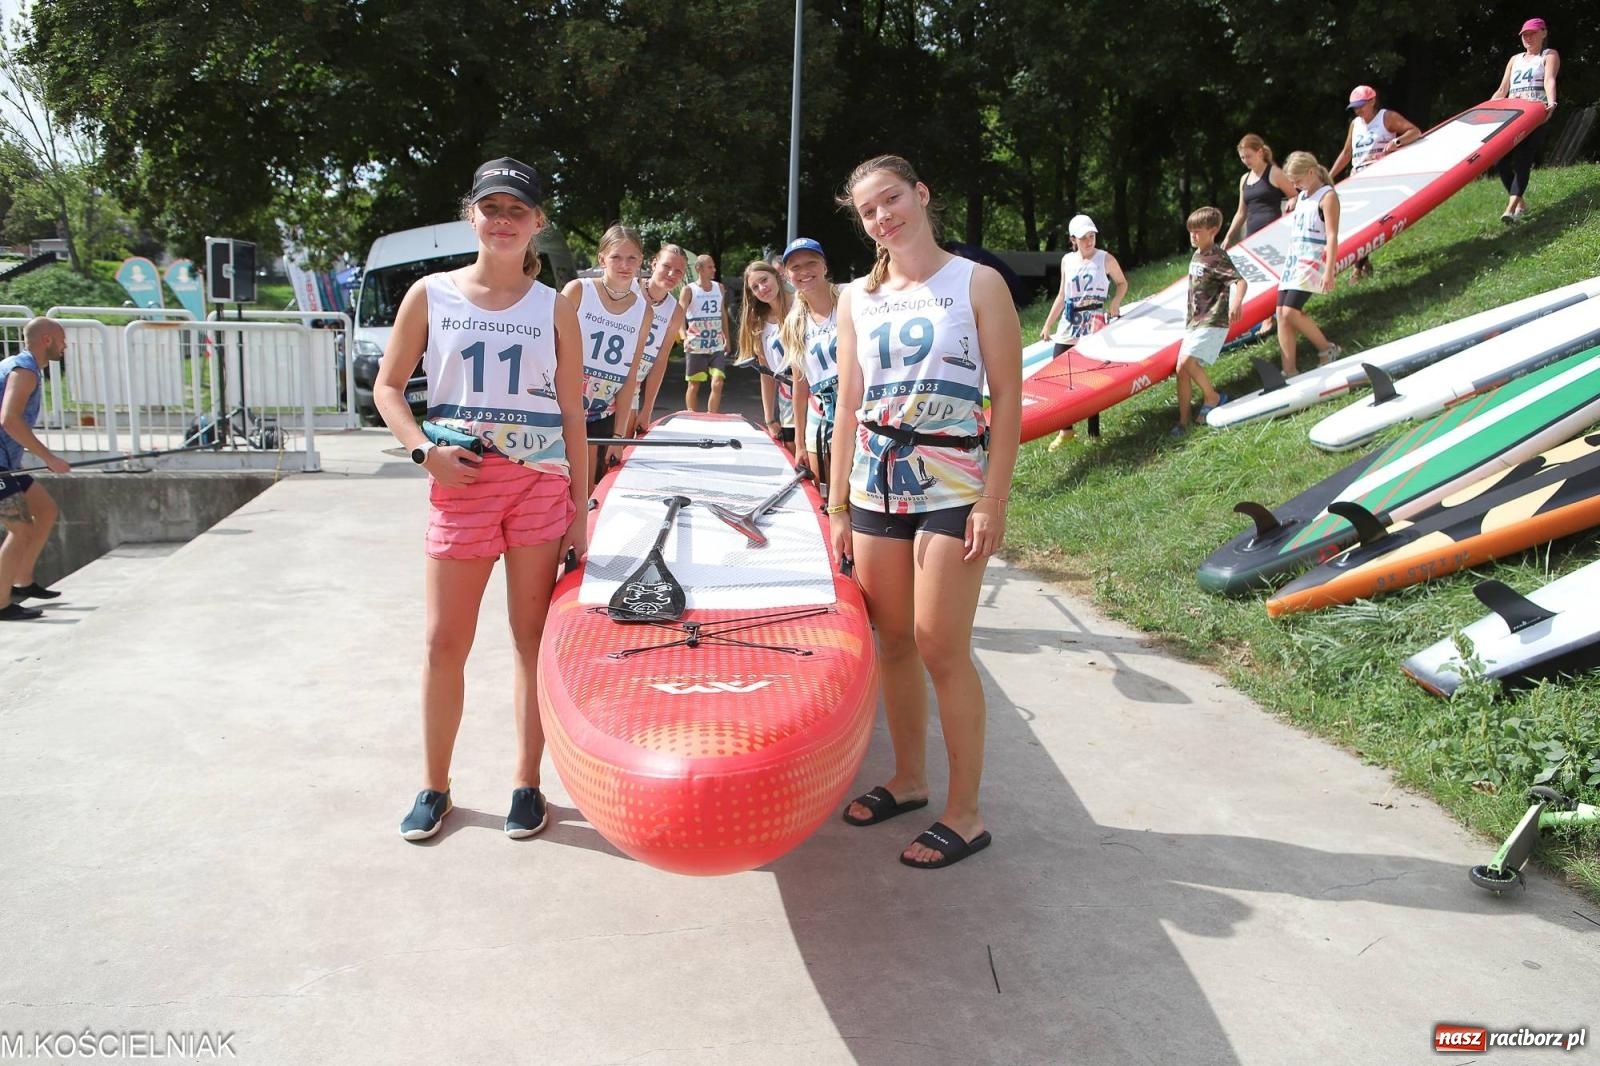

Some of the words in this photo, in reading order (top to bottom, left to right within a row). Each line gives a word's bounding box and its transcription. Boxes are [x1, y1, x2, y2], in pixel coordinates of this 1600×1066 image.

[1513, 68, 1533, 84] 24
[1357, 233, 1385, 260] RACE
[1072, 274, 1093, 292] 12
[701, 300, 718, 314] 43
[441, 316, 542, 338] #odrasupcup
[585, 312, 636, 334] #odrasupcup
[590, 331, 625, 365] 18
[869, 317, 935, 370] 19
[460, 341, 523, 395] 11
[915, 401, 954, 420] SUP
[506, 431, 548, 450] SUP
